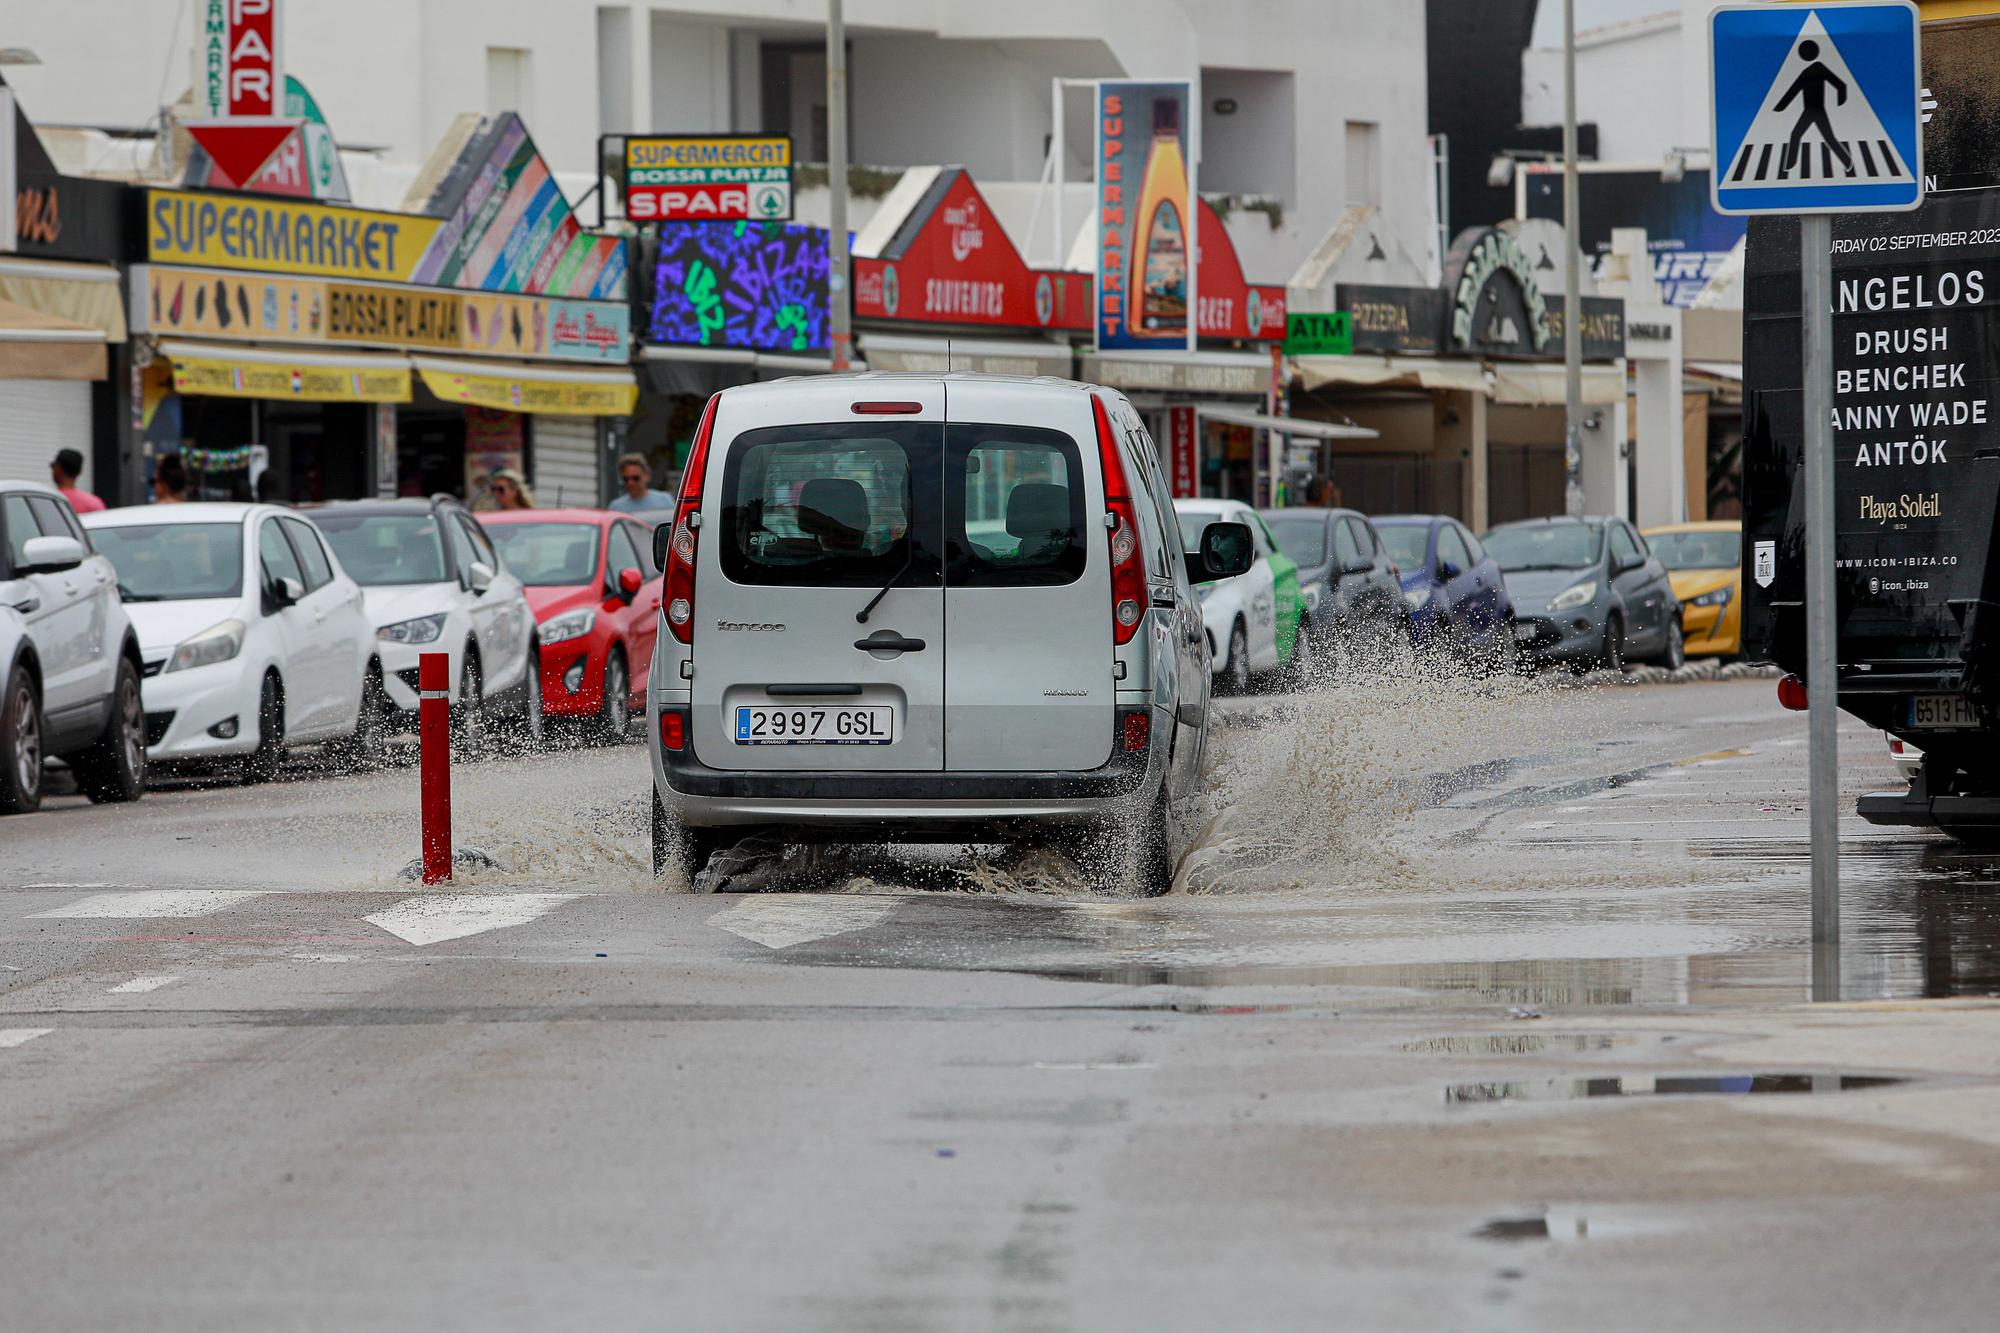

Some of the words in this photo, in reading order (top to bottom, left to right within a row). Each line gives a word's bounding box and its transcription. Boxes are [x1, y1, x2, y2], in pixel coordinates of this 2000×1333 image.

[231, 0, 271, 102] PAR
[631, 143, 786, 165] SUPERMERCAT
[630, 168, 706, 184] BOSSA
[710, 166, 788, 182] PLATJA
[629, 189, 747, 217] SPAR
[1102, 95, 1124, 337] SUPERMARKET
[154, 198, 399, 272] SUPERMARKET
[1869, 236, 1887, 251] 02
[1888, 231, 1967, 251] SEPTEMBER
[1968, 228, 2000, 245] 2023
[925, 277, 1004, 316] SOUVENIRS
[1831, 270, 1985, 313] NGELOS
[331, 292, 389, 336] BOSSA
[394, 296, 459, 342] PLATJA
[1292, 317, 1344, 337] ATM
[1351, 302, 1410, 332] PIZZERIA
[1855, 326, 1948, 356] DRUSH
[1836, 362, 1966, 394] BENCHEK
[1831, 404, 1901, 431] ANNY
[1909, 399, 1988, 428] WADE
[1855, 434, 1948, 467] ANTÖK
[1860, 495, 1898, 525] Playa
[1835, 556, 1958, 568] WWW.ICON-IBIZA.CO
[1881, 579, 1929, 591] icon_ibiza
[1043, 689, 1089, 697] RENAULT
[751, 711, 826, 736] 2997
[836, 711, 885, 736] GSL
[1916, 698, 1951, 723] 6513
